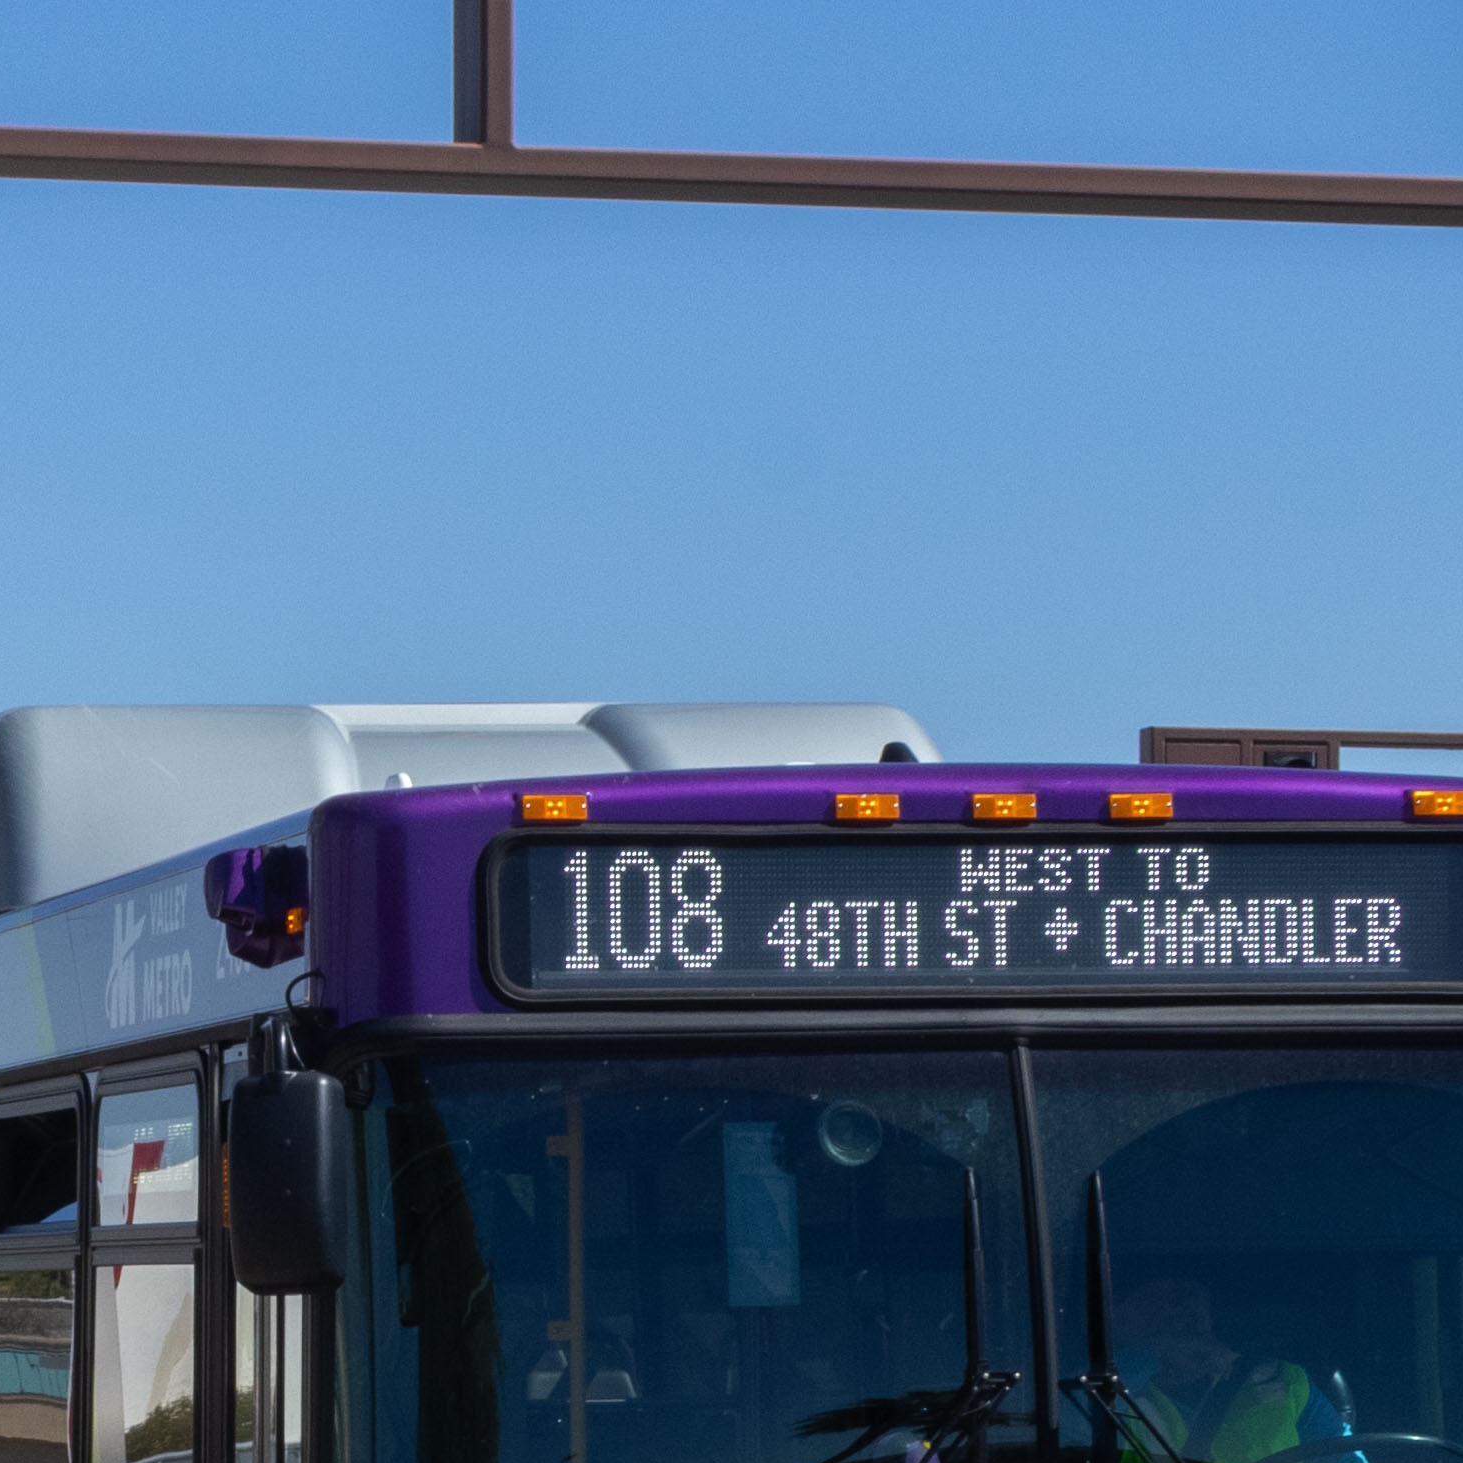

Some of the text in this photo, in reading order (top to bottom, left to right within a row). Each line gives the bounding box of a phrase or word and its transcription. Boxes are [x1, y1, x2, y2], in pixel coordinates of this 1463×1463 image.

[960, 847, 1210, 892] WEST TO
[150, 884, 188, 935] VALLEY
[563, 850, 723, 969] 108
[767, 901, 919, 968] 48TH
[944, 900, 1018, 966] ST
[1104, 898, 1401, 965] CHANDLER
[143, 949, 193, 1021] METRO
